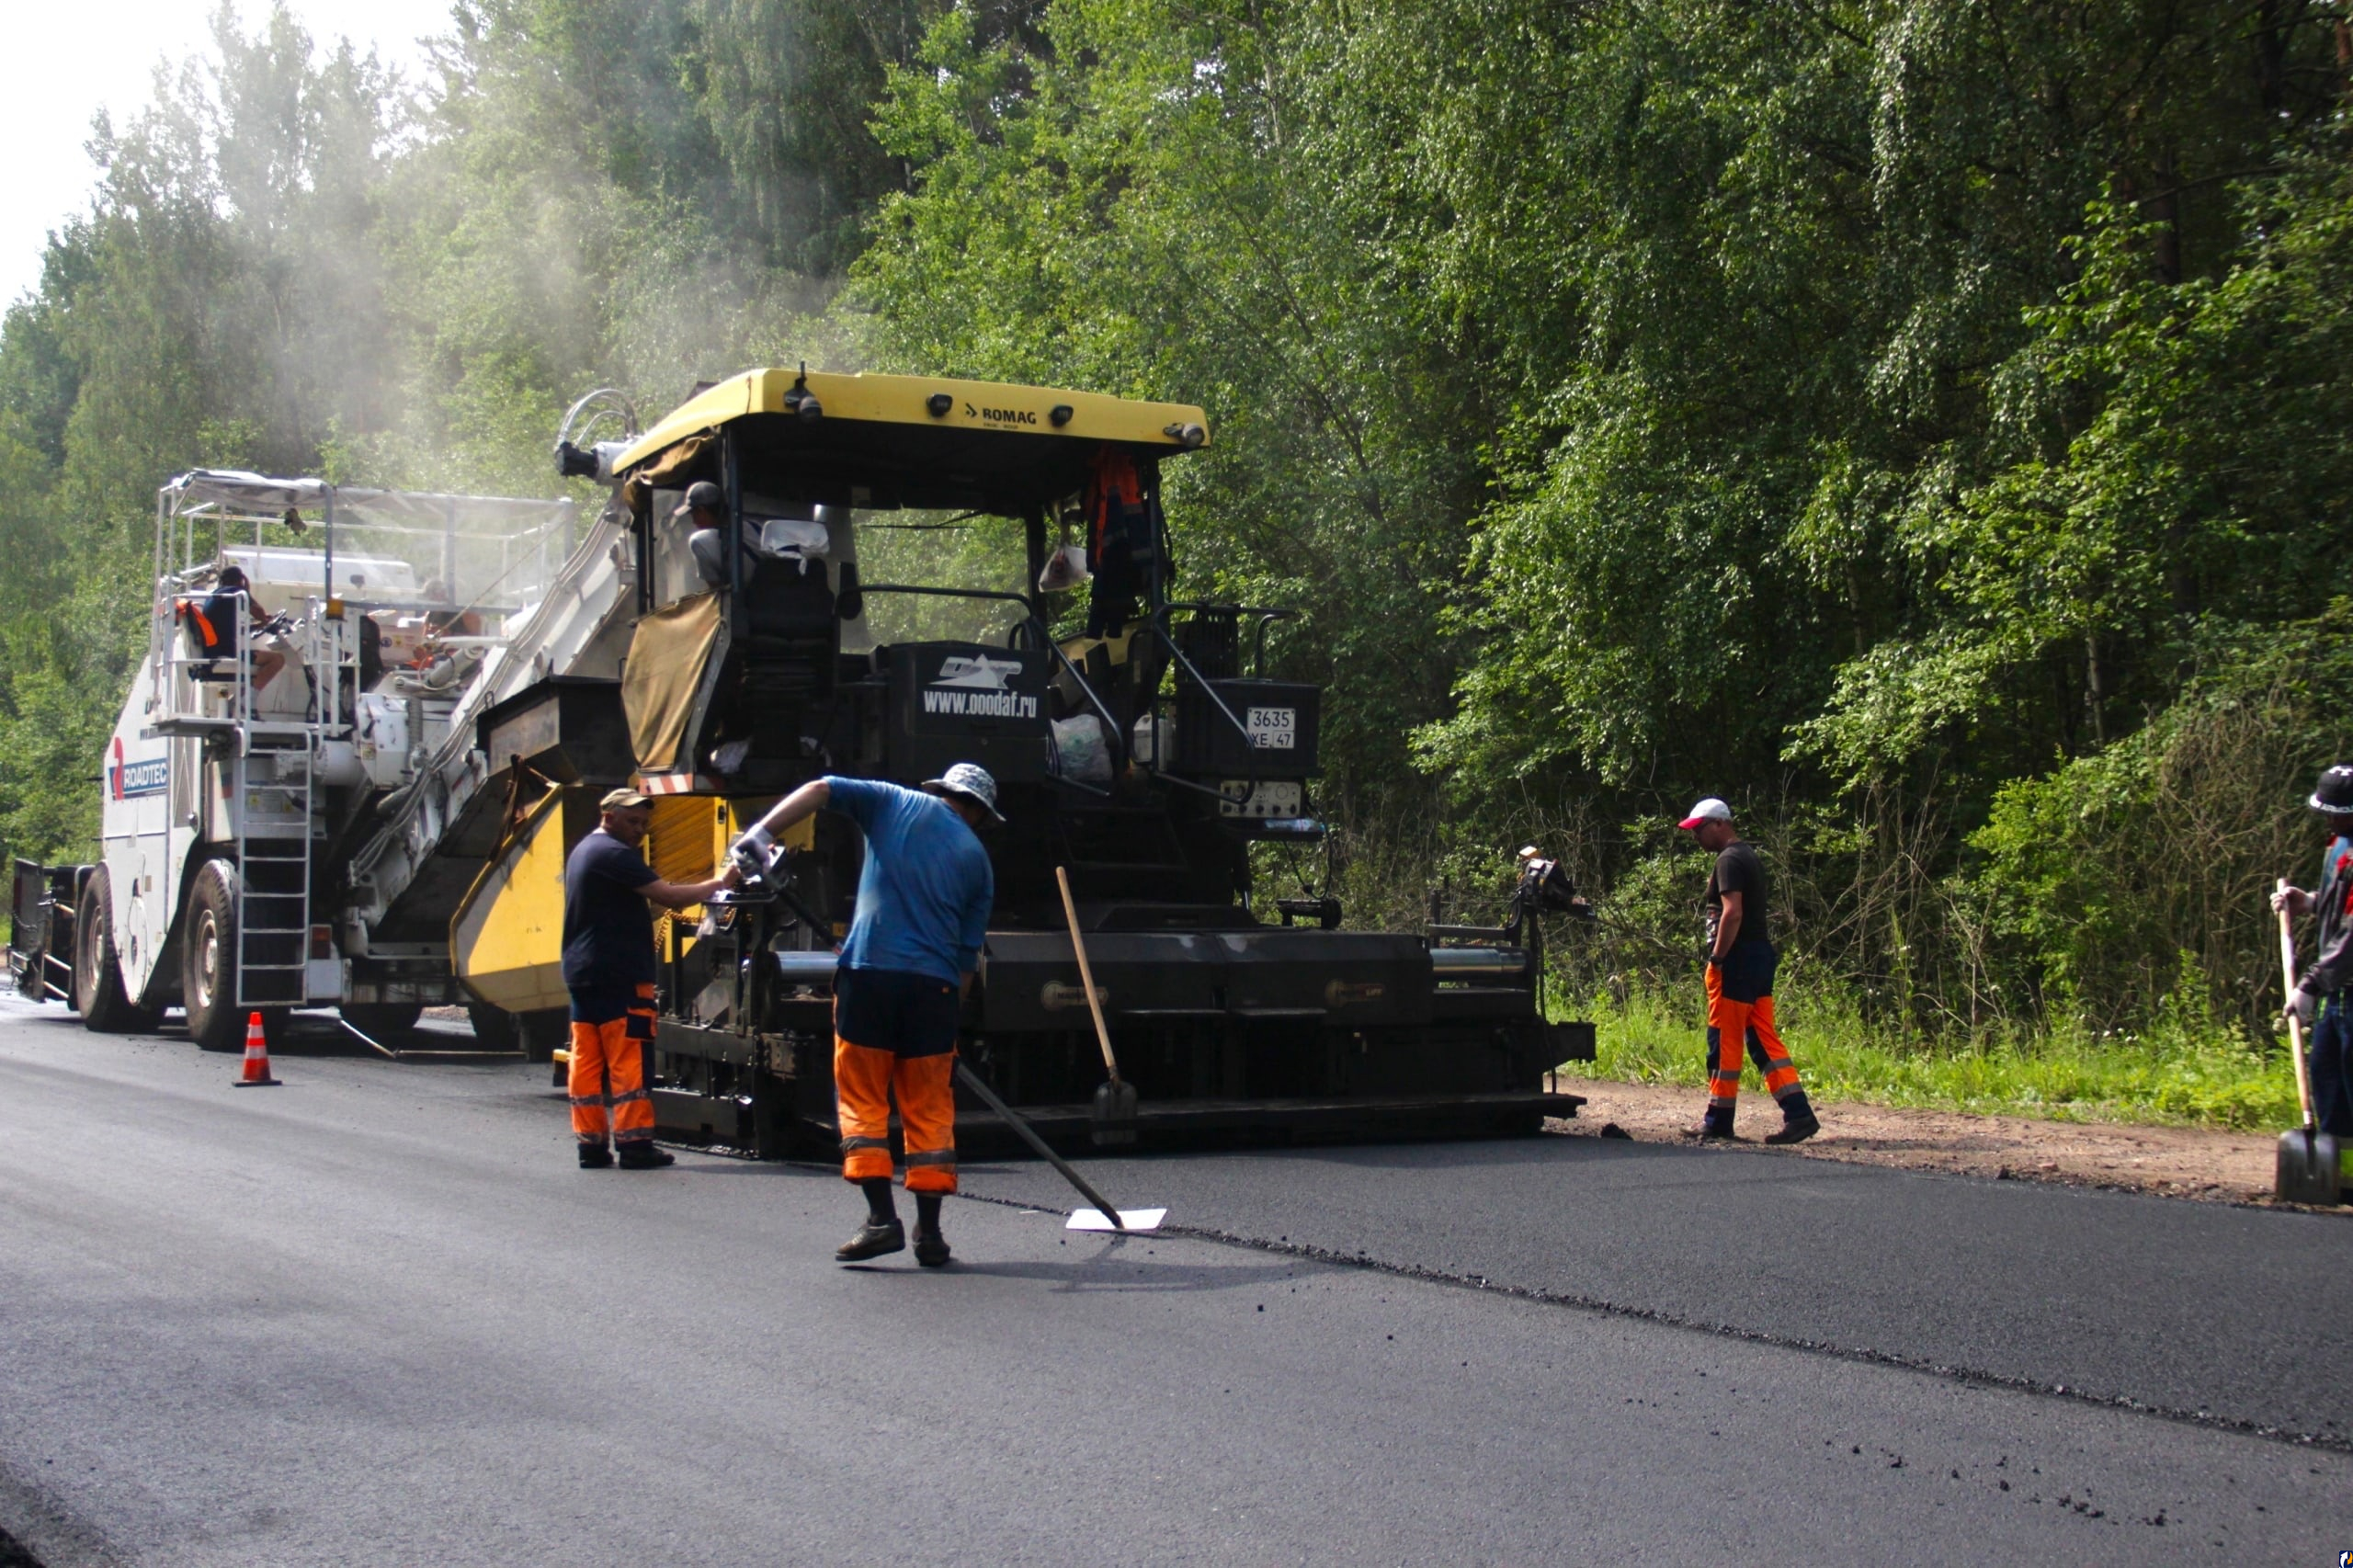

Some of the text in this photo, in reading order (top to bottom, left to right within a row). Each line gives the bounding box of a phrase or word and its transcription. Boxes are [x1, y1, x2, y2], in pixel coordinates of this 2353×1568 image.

[924, 690, 1037, 719] www.ooodaf.ru
[1254, 711, 1290, 727] 3635
[1277, 733, 1290, 746] 47
[123, 762, 167, 789] ROADTEC
